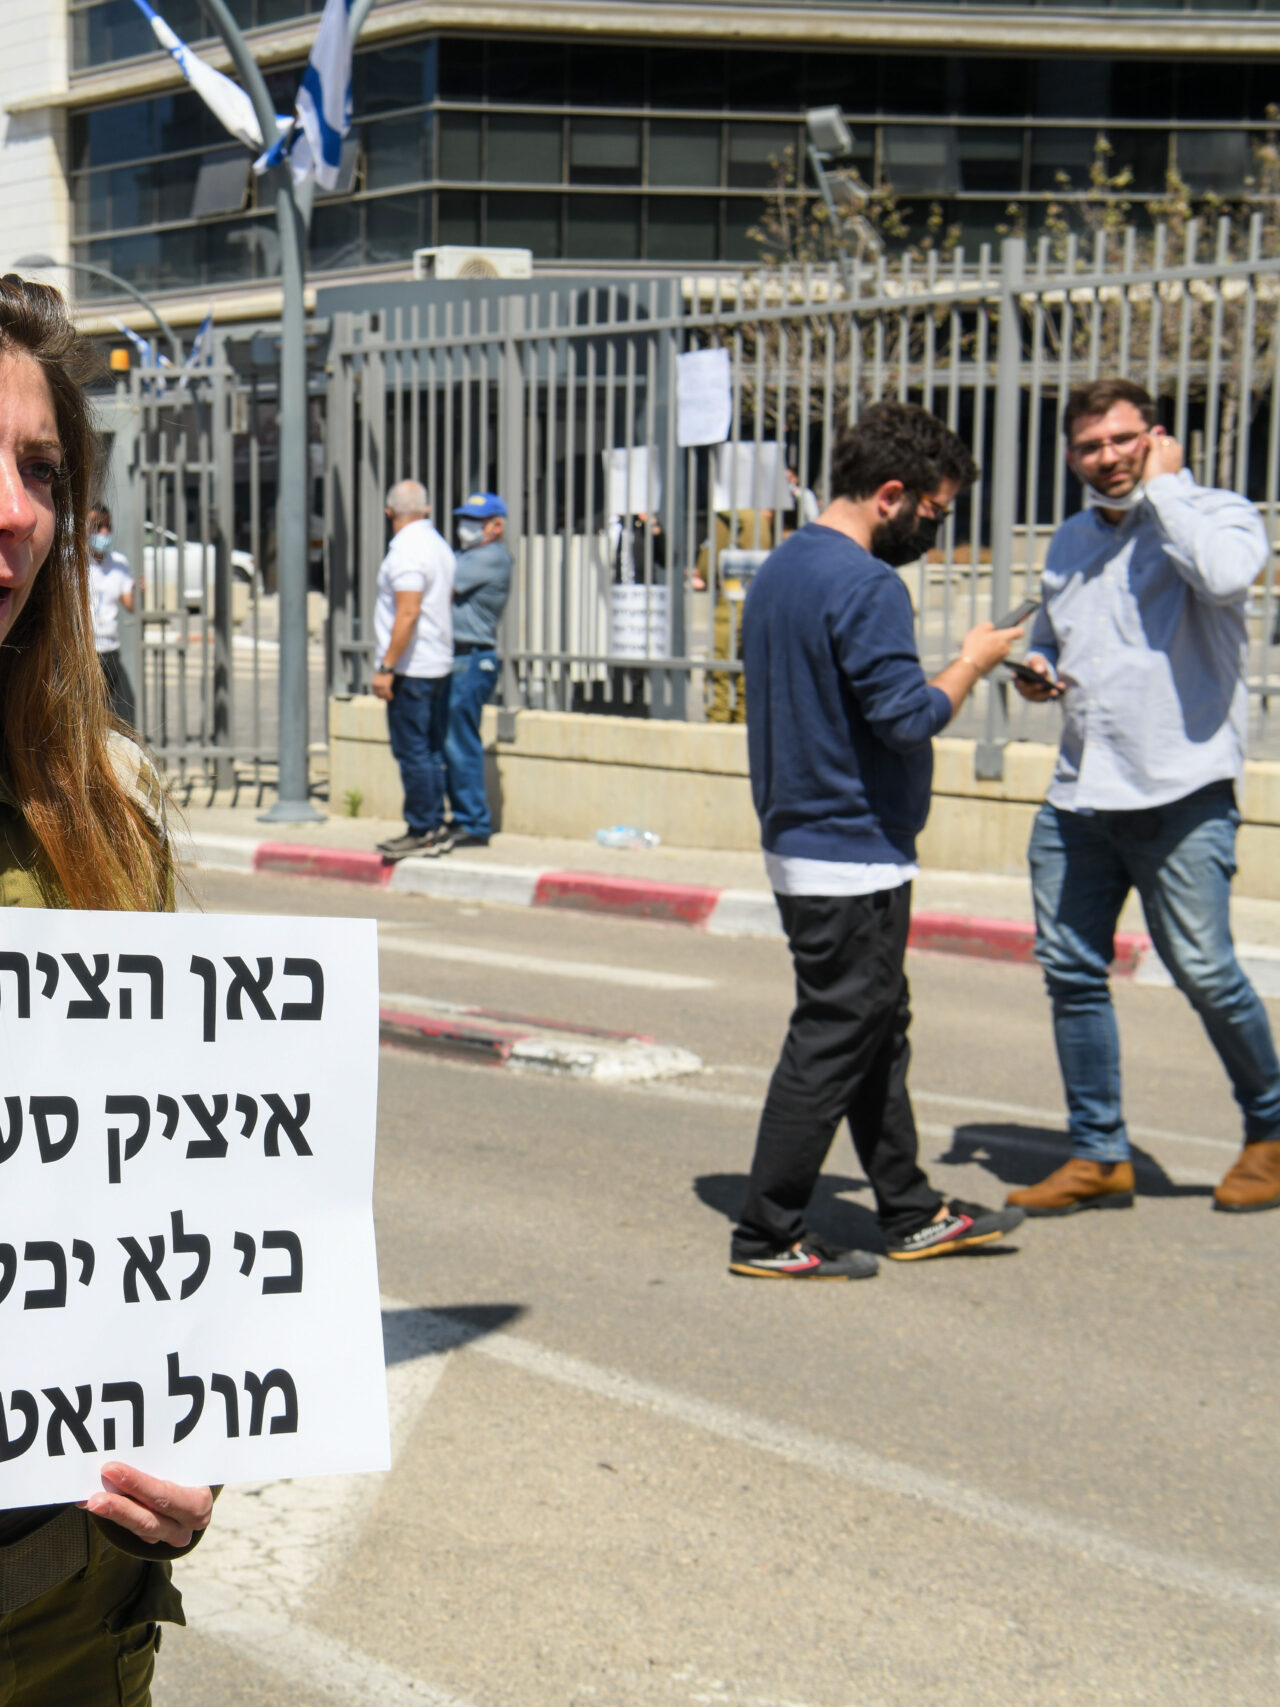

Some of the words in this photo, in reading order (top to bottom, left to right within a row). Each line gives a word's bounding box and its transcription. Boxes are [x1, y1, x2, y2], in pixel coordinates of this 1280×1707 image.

[189, 954, 325, 1042] כאן
[104, 1093, 314, 1184] איציק
[117, 1209, 211, 1304] לא
[233, 1230, 304, 1295] כי
[166, 1351, 299, 1444] מול
